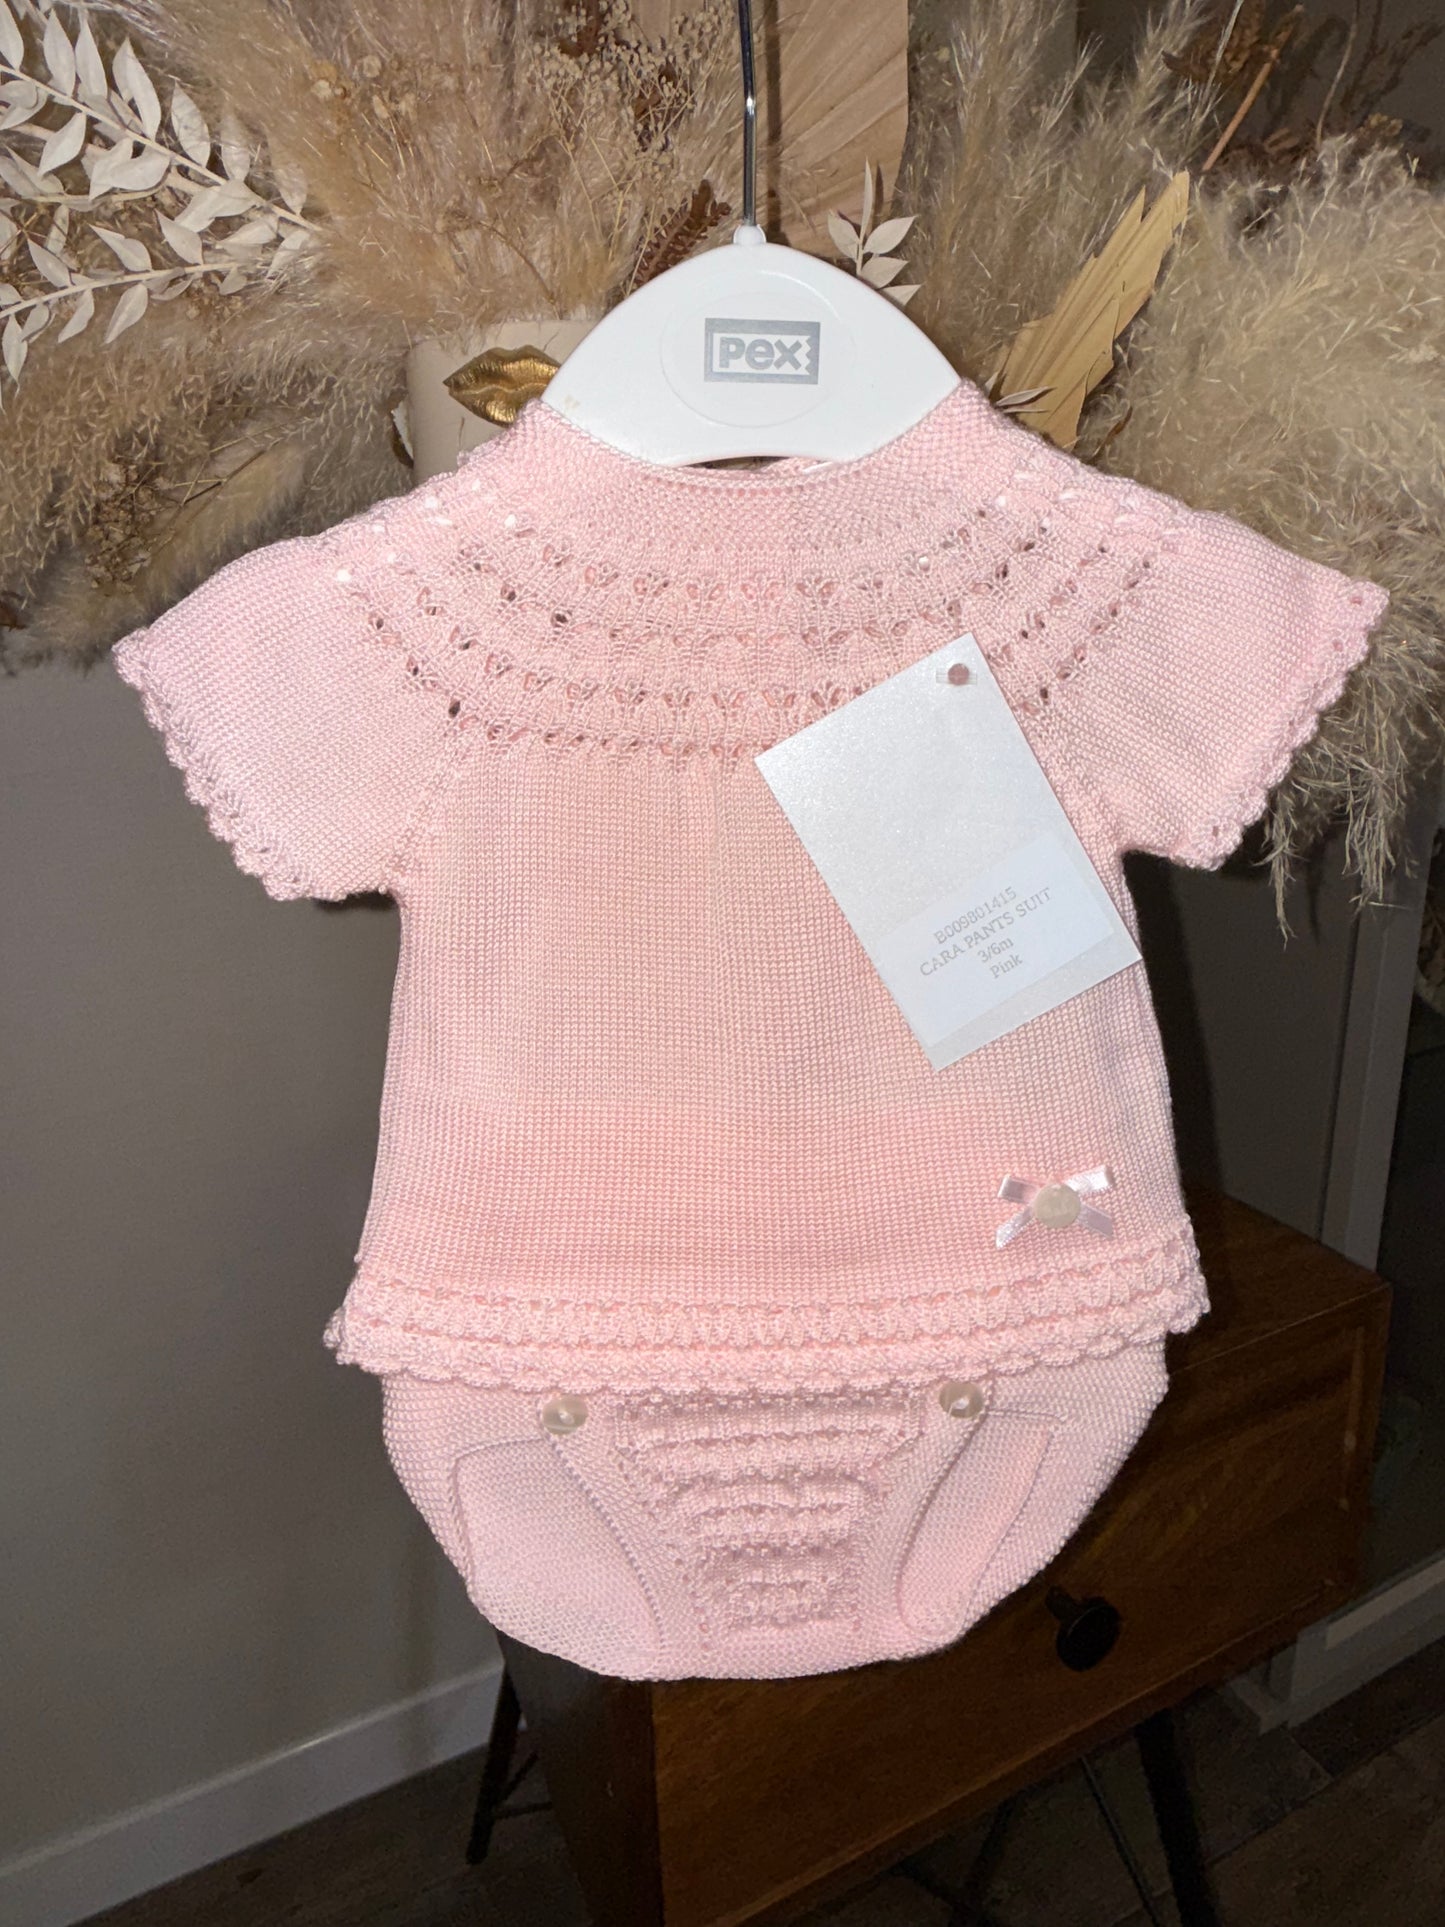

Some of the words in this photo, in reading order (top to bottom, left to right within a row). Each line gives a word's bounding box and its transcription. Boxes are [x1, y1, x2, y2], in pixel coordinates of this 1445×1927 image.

[718, 337, 802, 370] pex
[919, 944, 966, 976] CARA
[963, 911, 1015, 949] PANTS
[1015, 887, 1053, 918] SUIT
[933, 886, 1017, 945] B009801415
[977, 937, 1014, 963] 3/6m
[989, 953, 1024, 979] Pink
